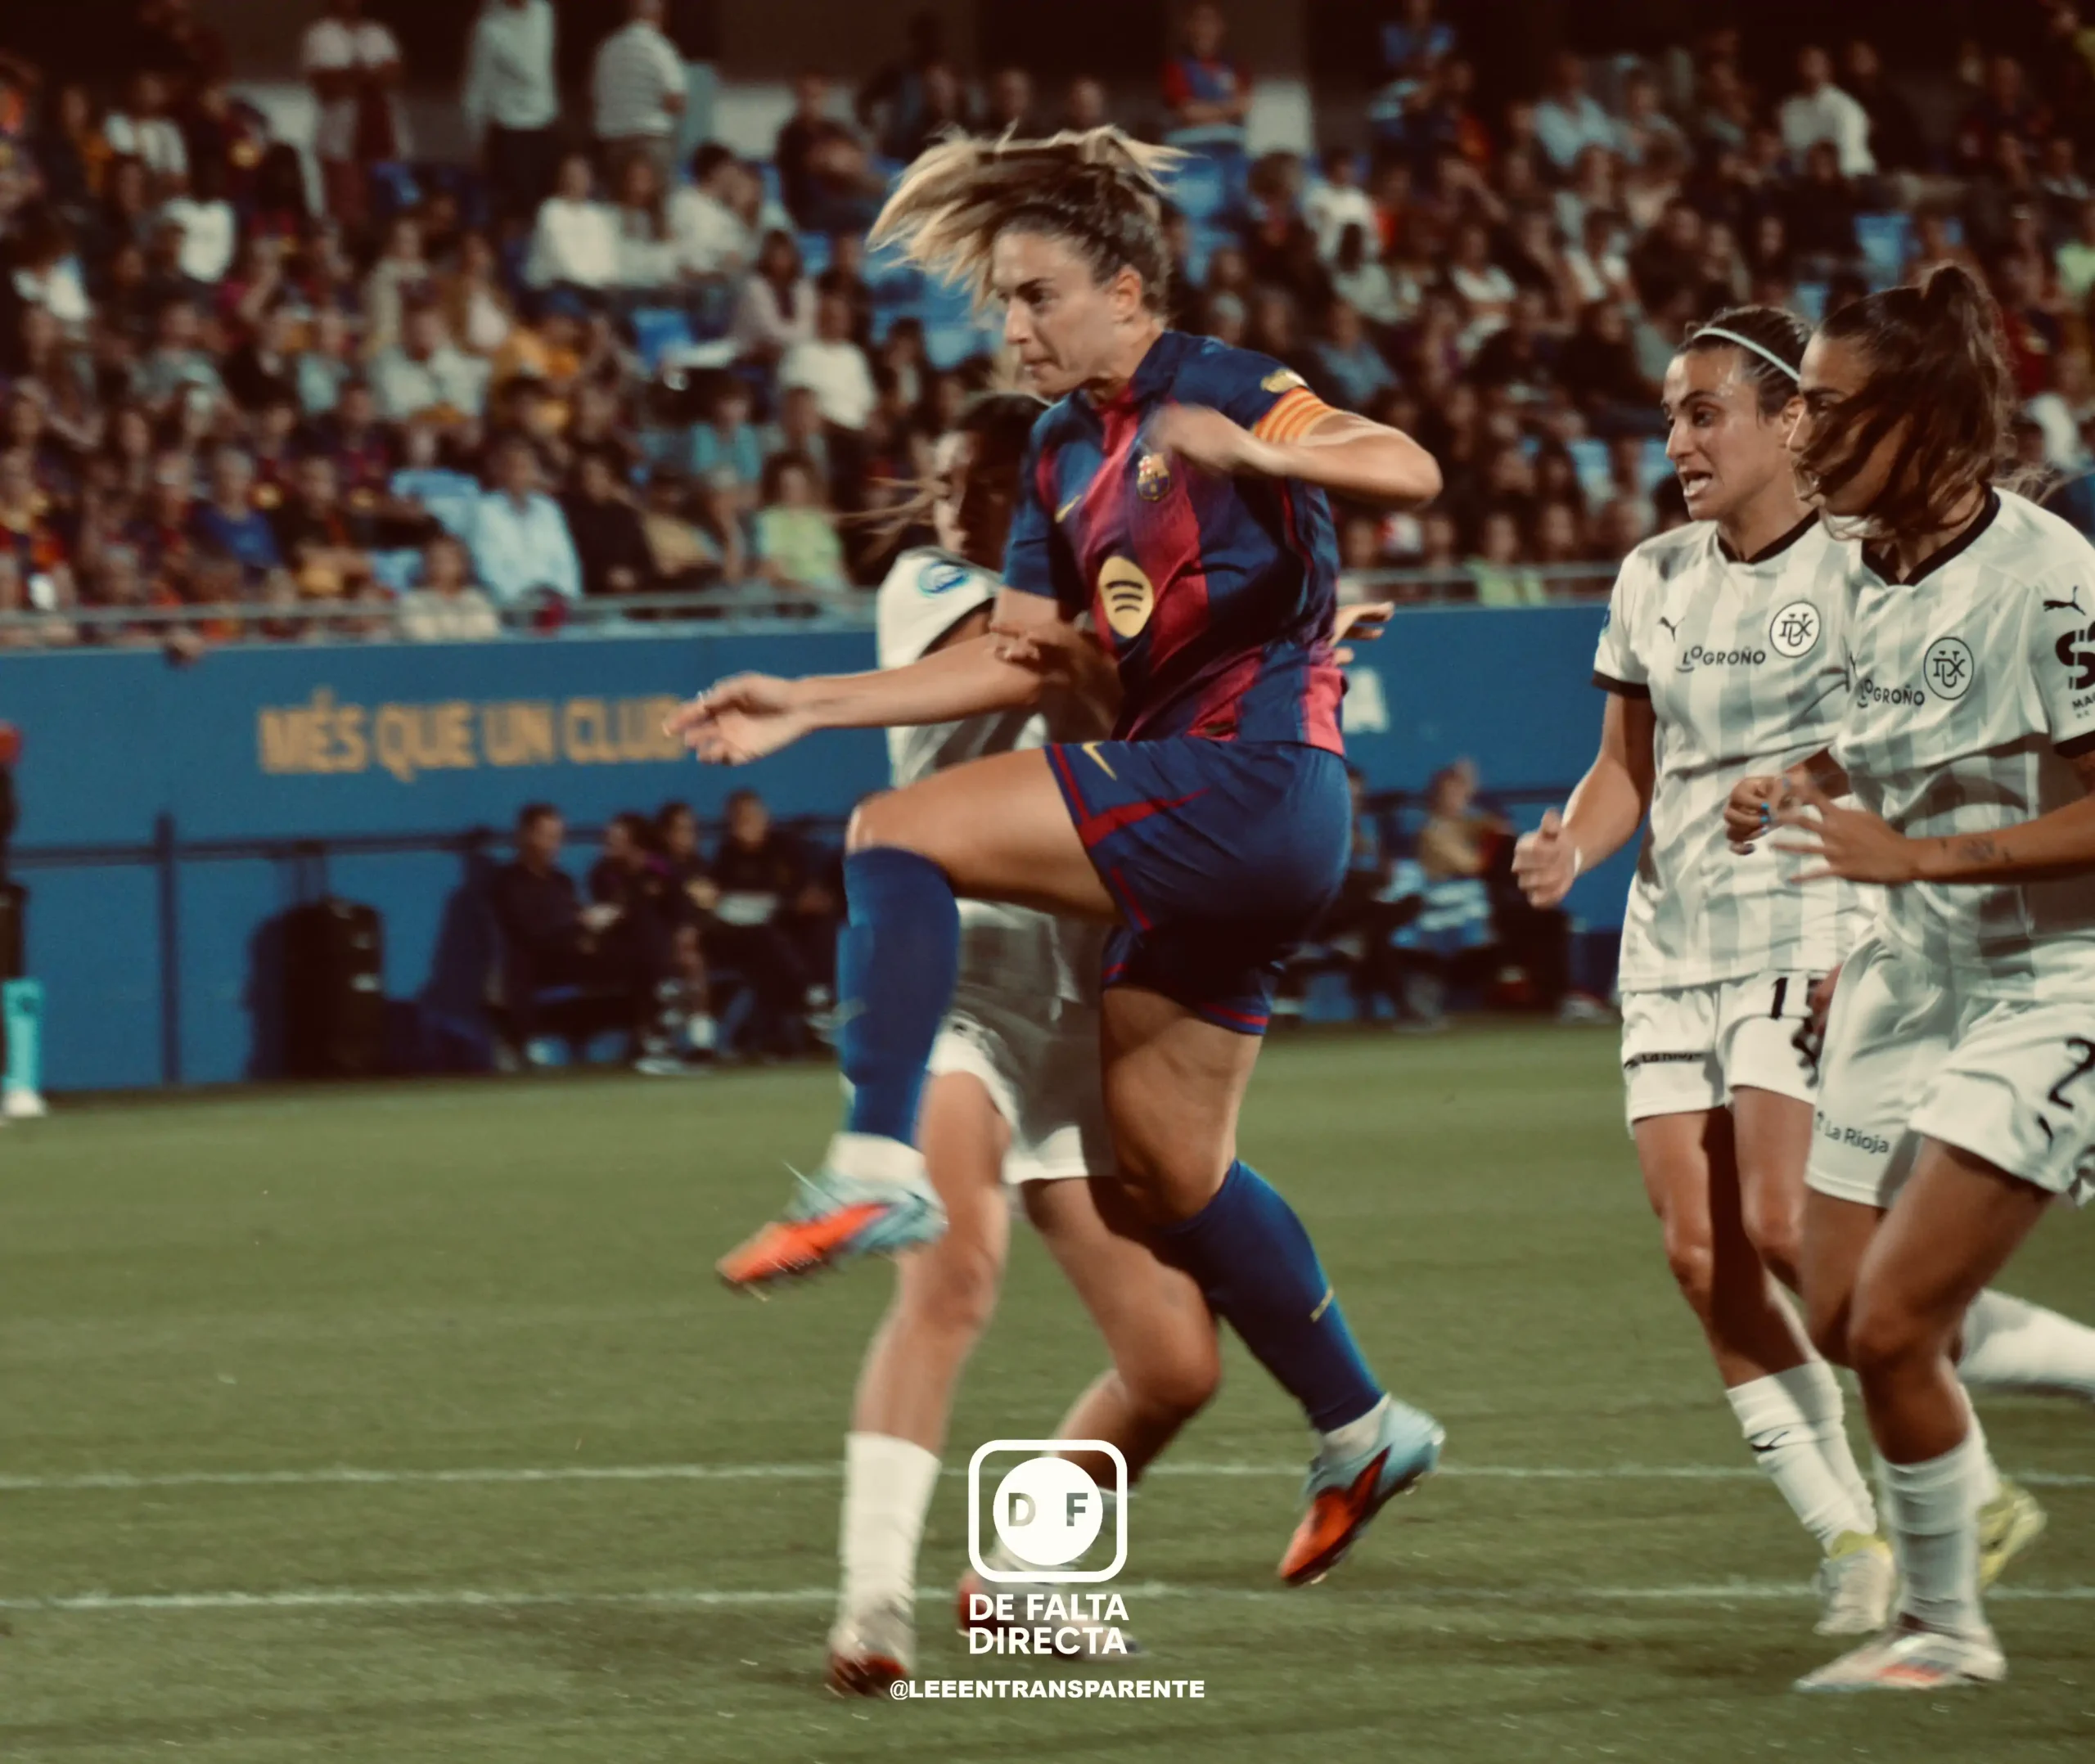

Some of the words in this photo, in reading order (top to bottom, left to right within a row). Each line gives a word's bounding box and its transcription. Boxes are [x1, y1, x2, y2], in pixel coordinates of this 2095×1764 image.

[1679, 645, 1766, 669] LOGROÑO
[259, 686, 367, 774] MÉS
[376, 700, 475, 783] QUE
[484, 700, 554, 767] UN
[1825, 1121, 1841, 1141] La
[1844, 1127, 1890, 1154] Rioja
